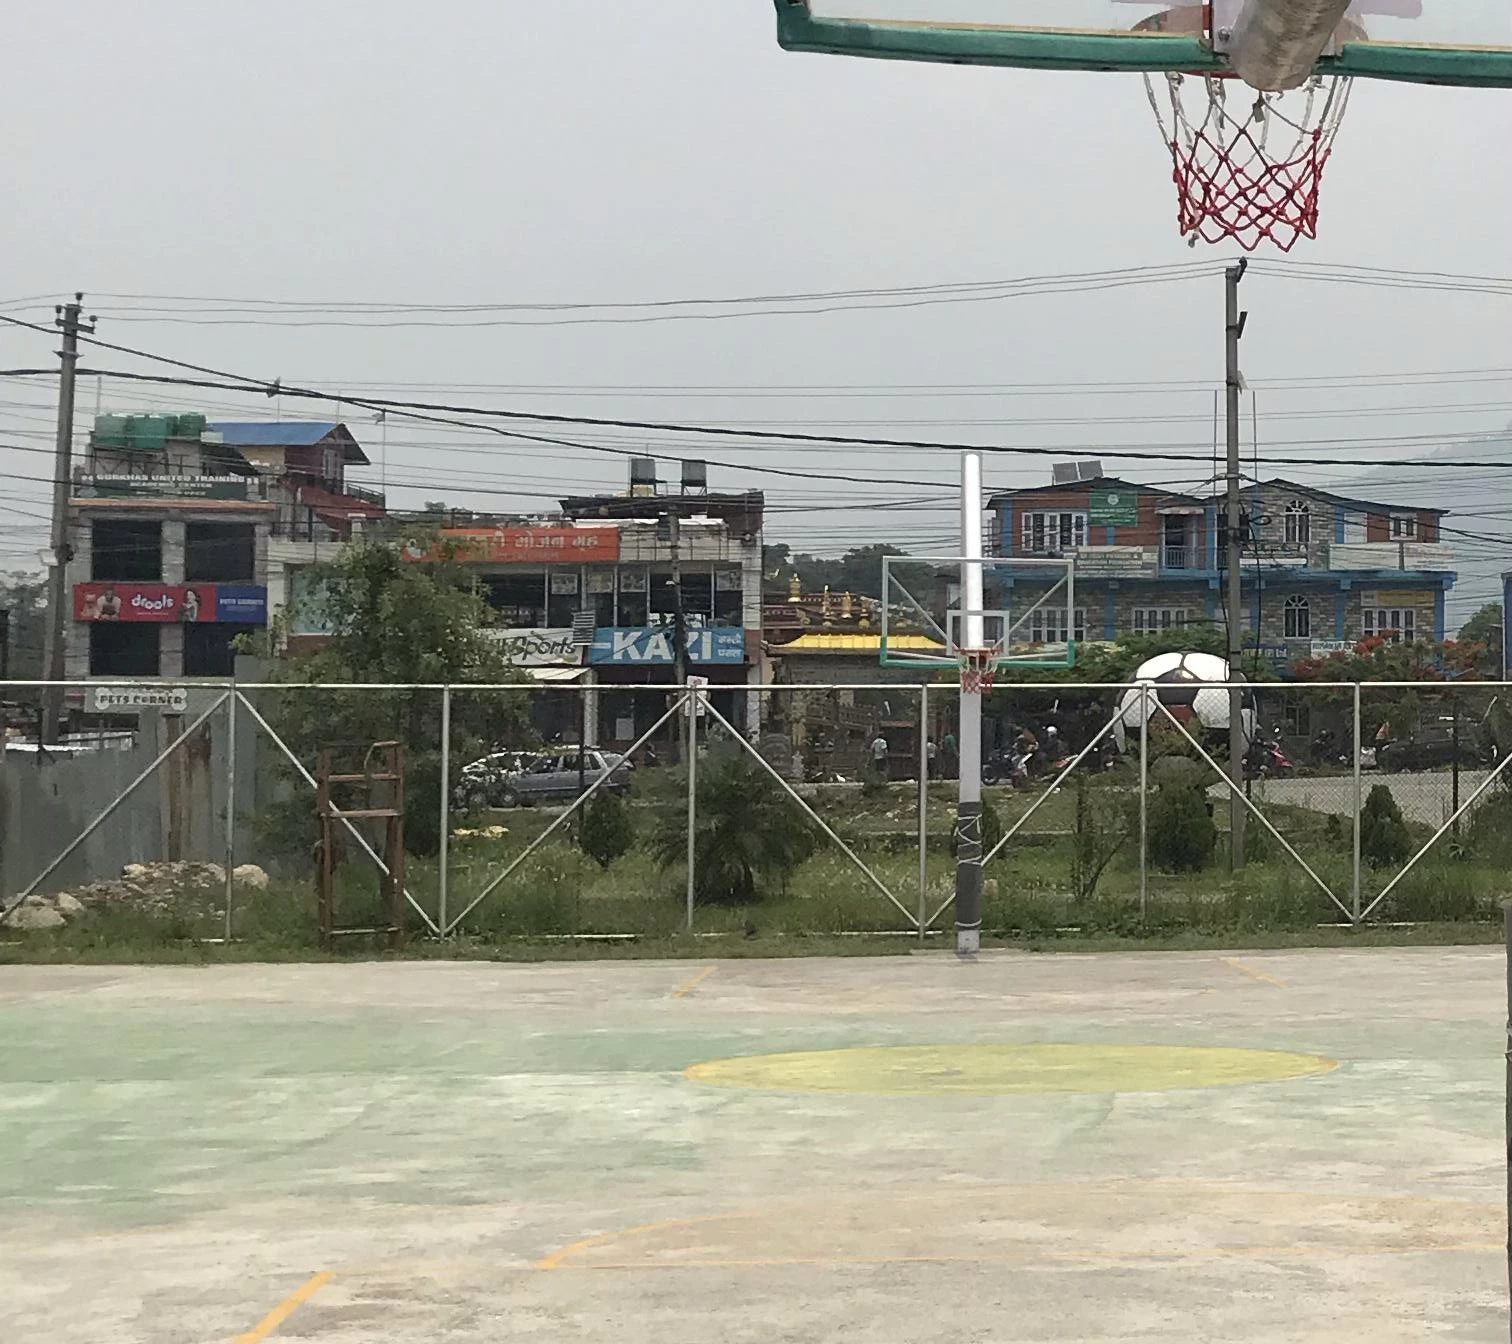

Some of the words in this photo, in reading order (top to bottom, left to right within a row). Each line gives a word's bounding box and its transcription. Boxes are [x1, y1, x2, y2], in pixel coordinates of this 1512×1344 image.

[131, 594, 174, 609] drools
[100, 695, 129, 704] PETS
[133, 695, 182, 704] CORNER
